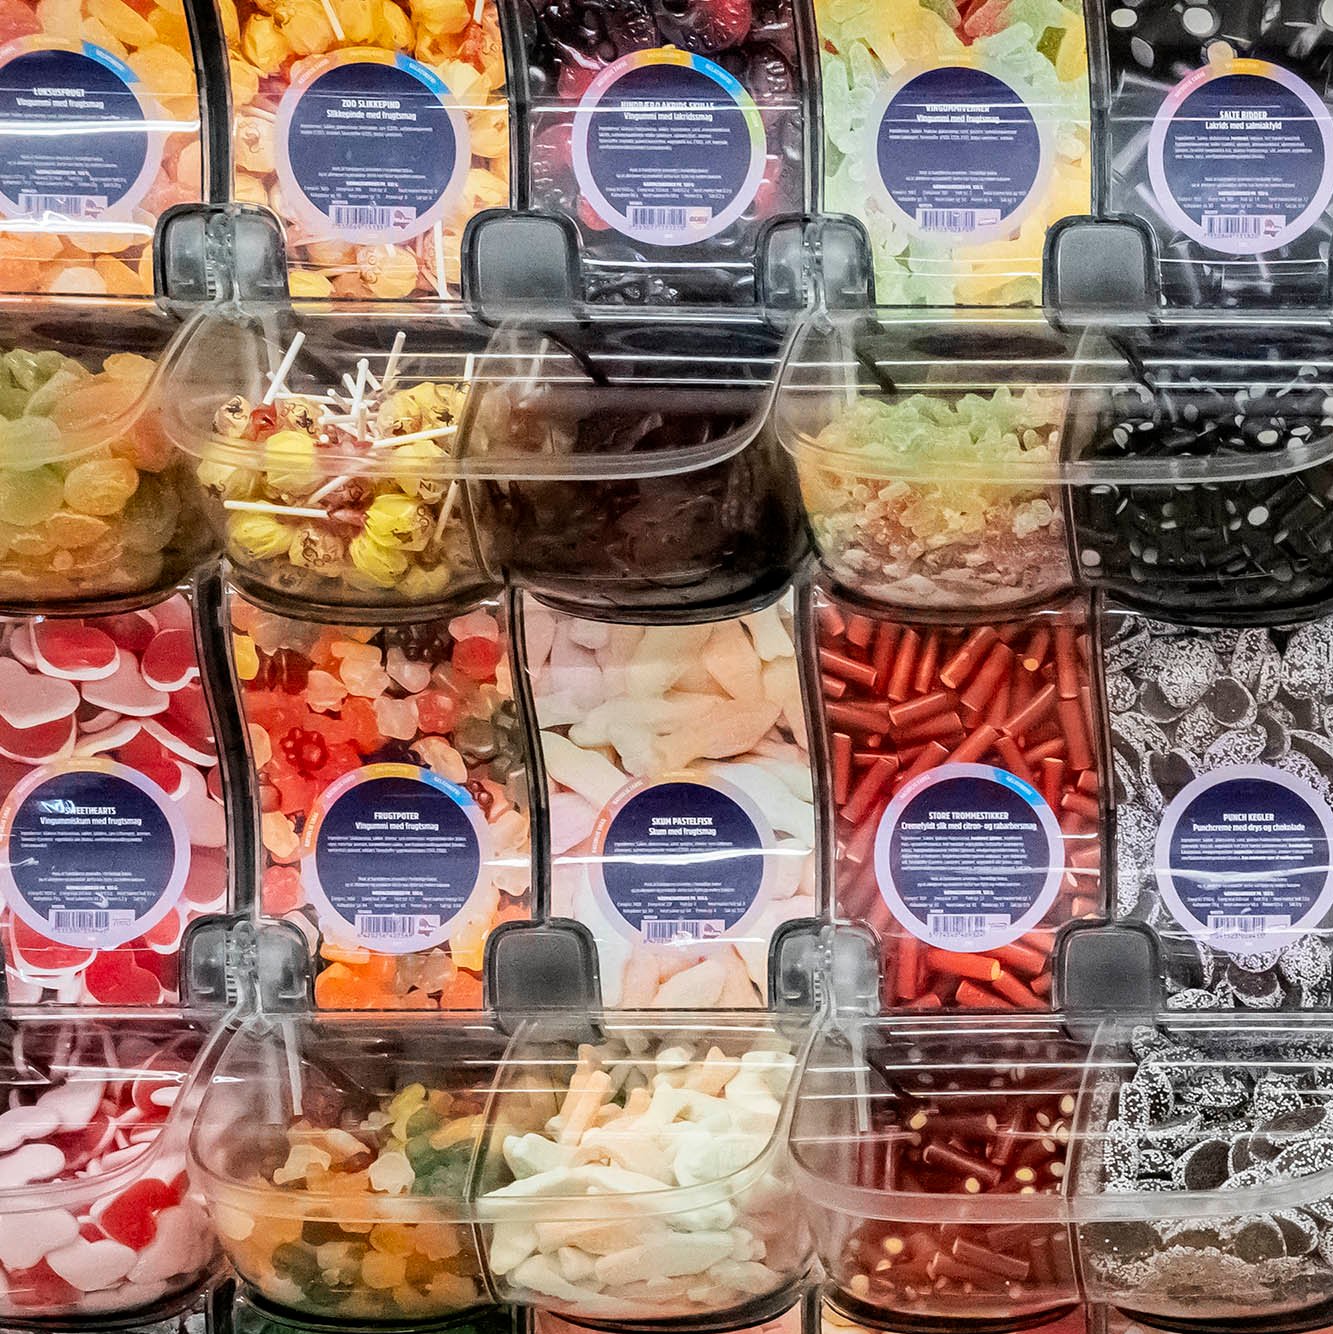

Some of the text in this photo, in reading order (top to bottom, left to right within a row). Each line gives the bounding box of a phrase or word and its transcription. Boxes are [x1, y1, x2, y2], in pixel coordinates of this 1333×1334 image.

[342, 100, 400, 109] ZOO SLIKKEPIND
[327, 110, 416, 121] Slikkepinde med frugtsmag
[1220, 111, 1268, 119] SALTE BIDDER
[1206, 121, 1228, 129] Lakrids
[1230, 121, 1244, 129] med
[374, 812, 419, 821] FRUGTPOTER
[929, 812, 1008, 820] STORE TROMMESTIKKER
[1223, 813, 1274, 821] PUNCH KEGLER
[652, 817, 712, 826] SKUM PASTELFISK
[356, 822, 439, 831] Vingummi med frugtsmag
[936, 822, 947, 830] slik
[948, 822, 962, 830] med
[984, 823, 992, 831] og
[994, 822, 1037, 831] rabarbersmag
[1233, 823, 1247, 831] med
[1248, 823, 1262, 832] drys
[1263, 824, 1272, 832] og
[1273, 823, 1305, 831] chokolade
[649, 827, 716, 836] Skum med frugtsmag
